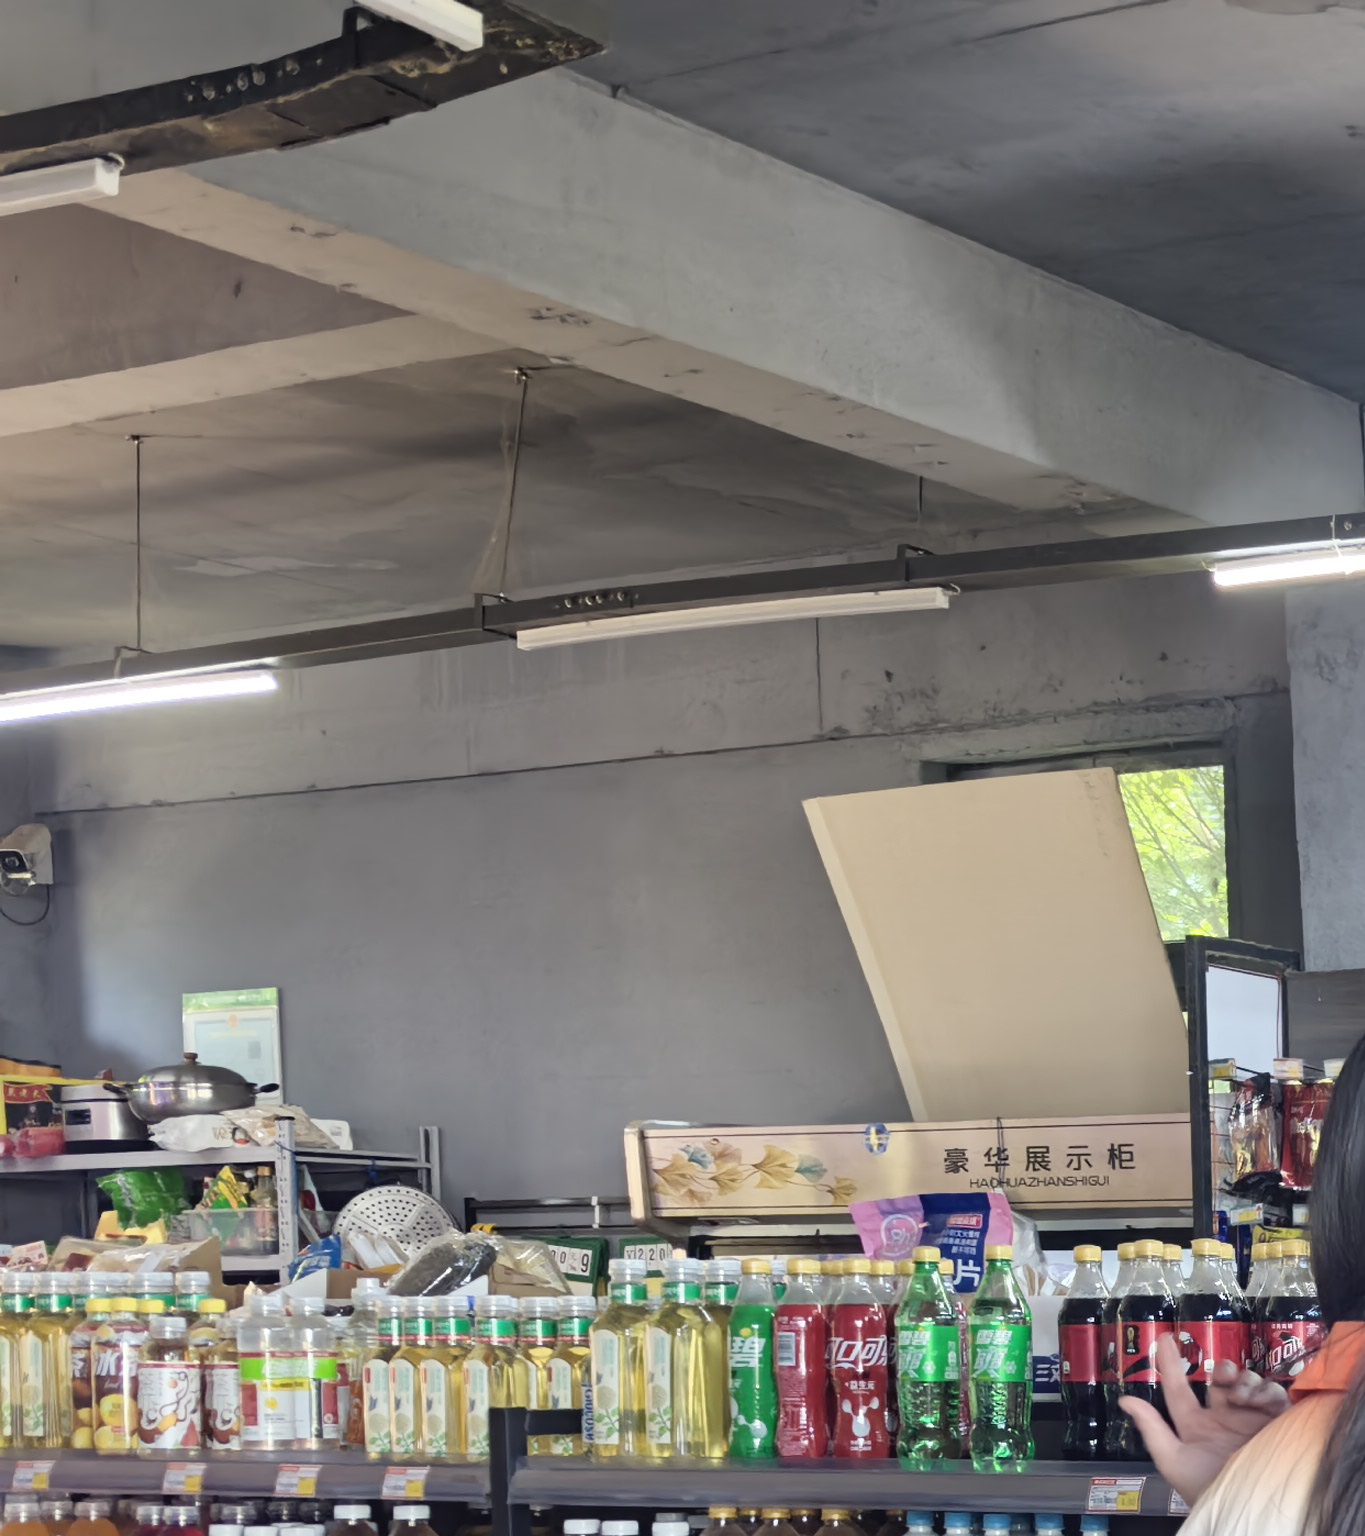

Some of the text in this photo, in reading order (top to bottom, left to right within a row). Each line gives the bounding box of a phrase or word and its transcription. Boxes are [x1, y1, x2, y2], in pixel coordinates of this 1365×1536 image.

[943, 1142, 1136, 1174] 豪华展示柜
[969, 1175, 1111, 1189] HAOHUAZHANSHIGUI
